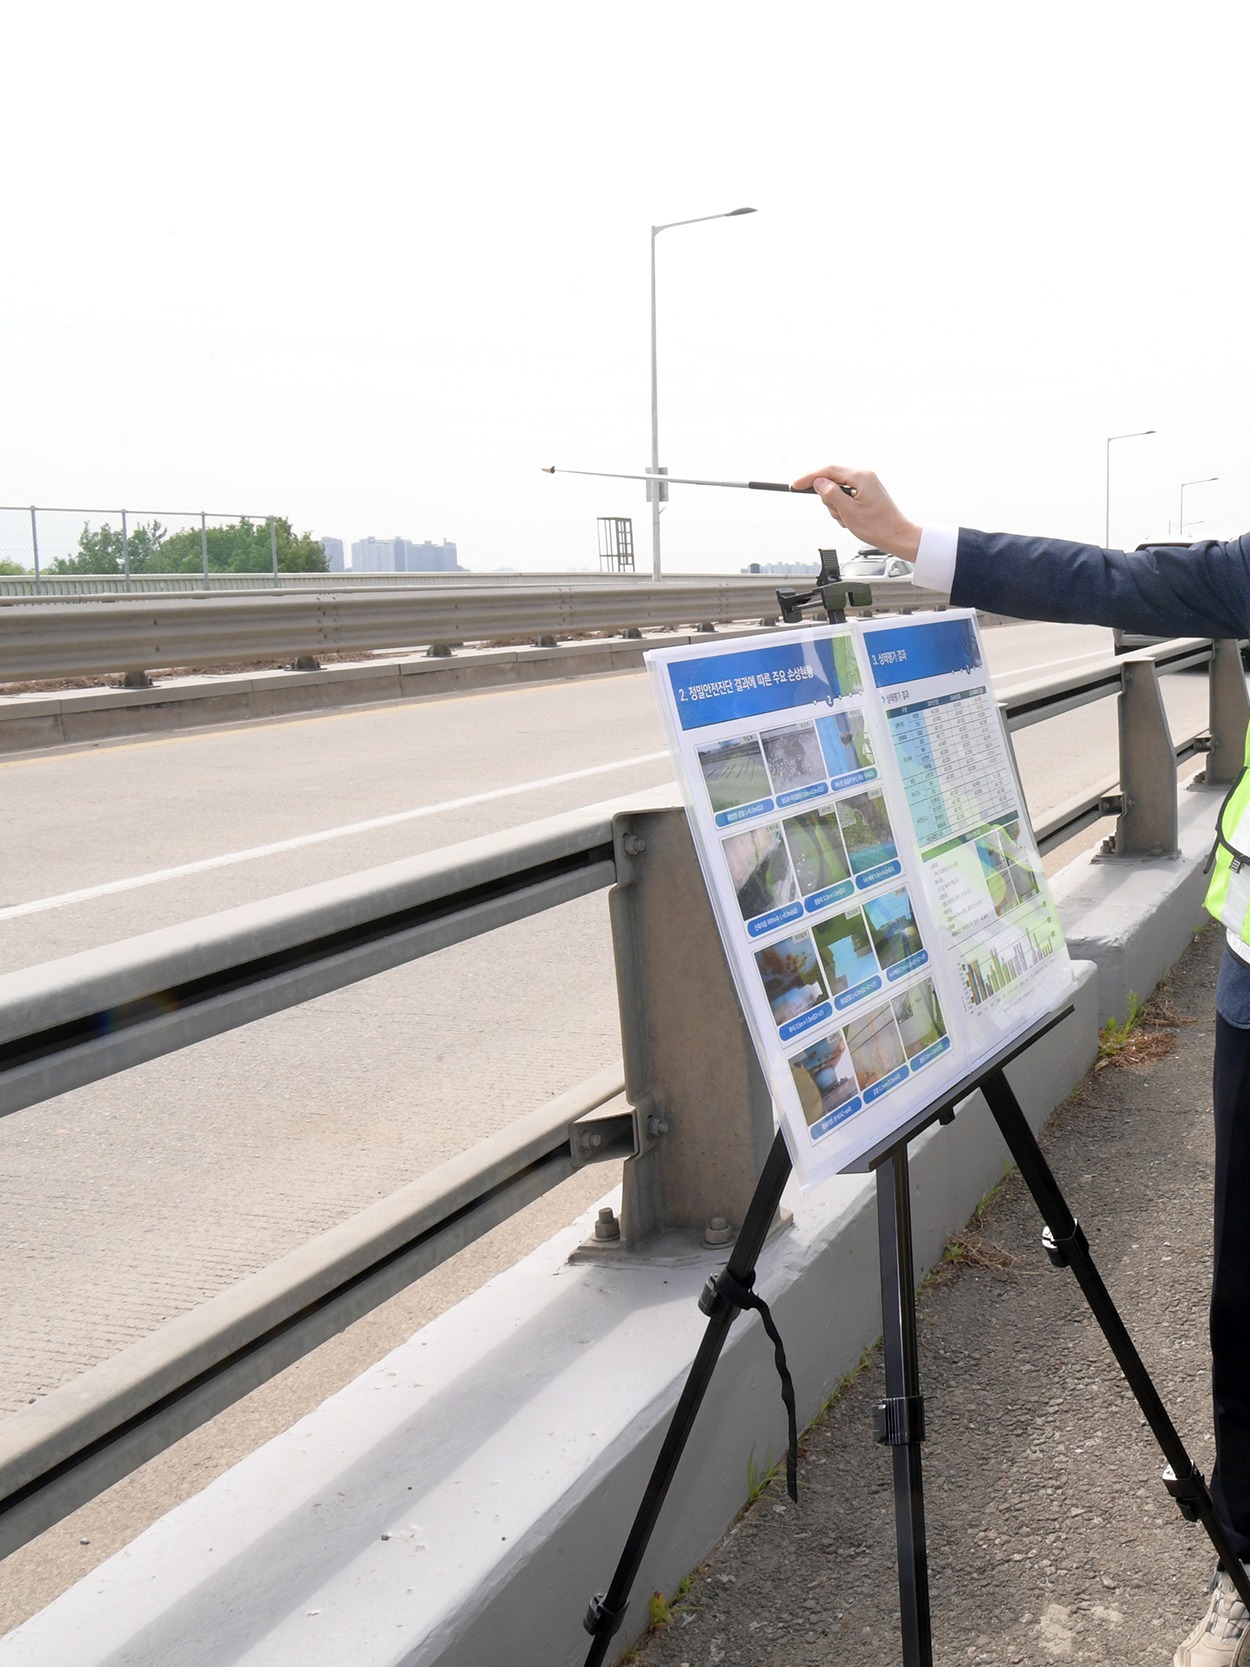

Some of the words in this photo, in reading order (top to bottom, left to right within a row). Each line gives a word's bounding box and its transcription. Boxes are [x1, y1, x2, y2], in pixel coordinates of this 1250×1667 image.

[679, 688, 689, 702] 2.
[689, 680, 734, 701] 정밀안전진단
[734, 675, 757, 692] 결과에
[757, 672, 772, 687] 따른
[772, 670, 788, 685] 주요
